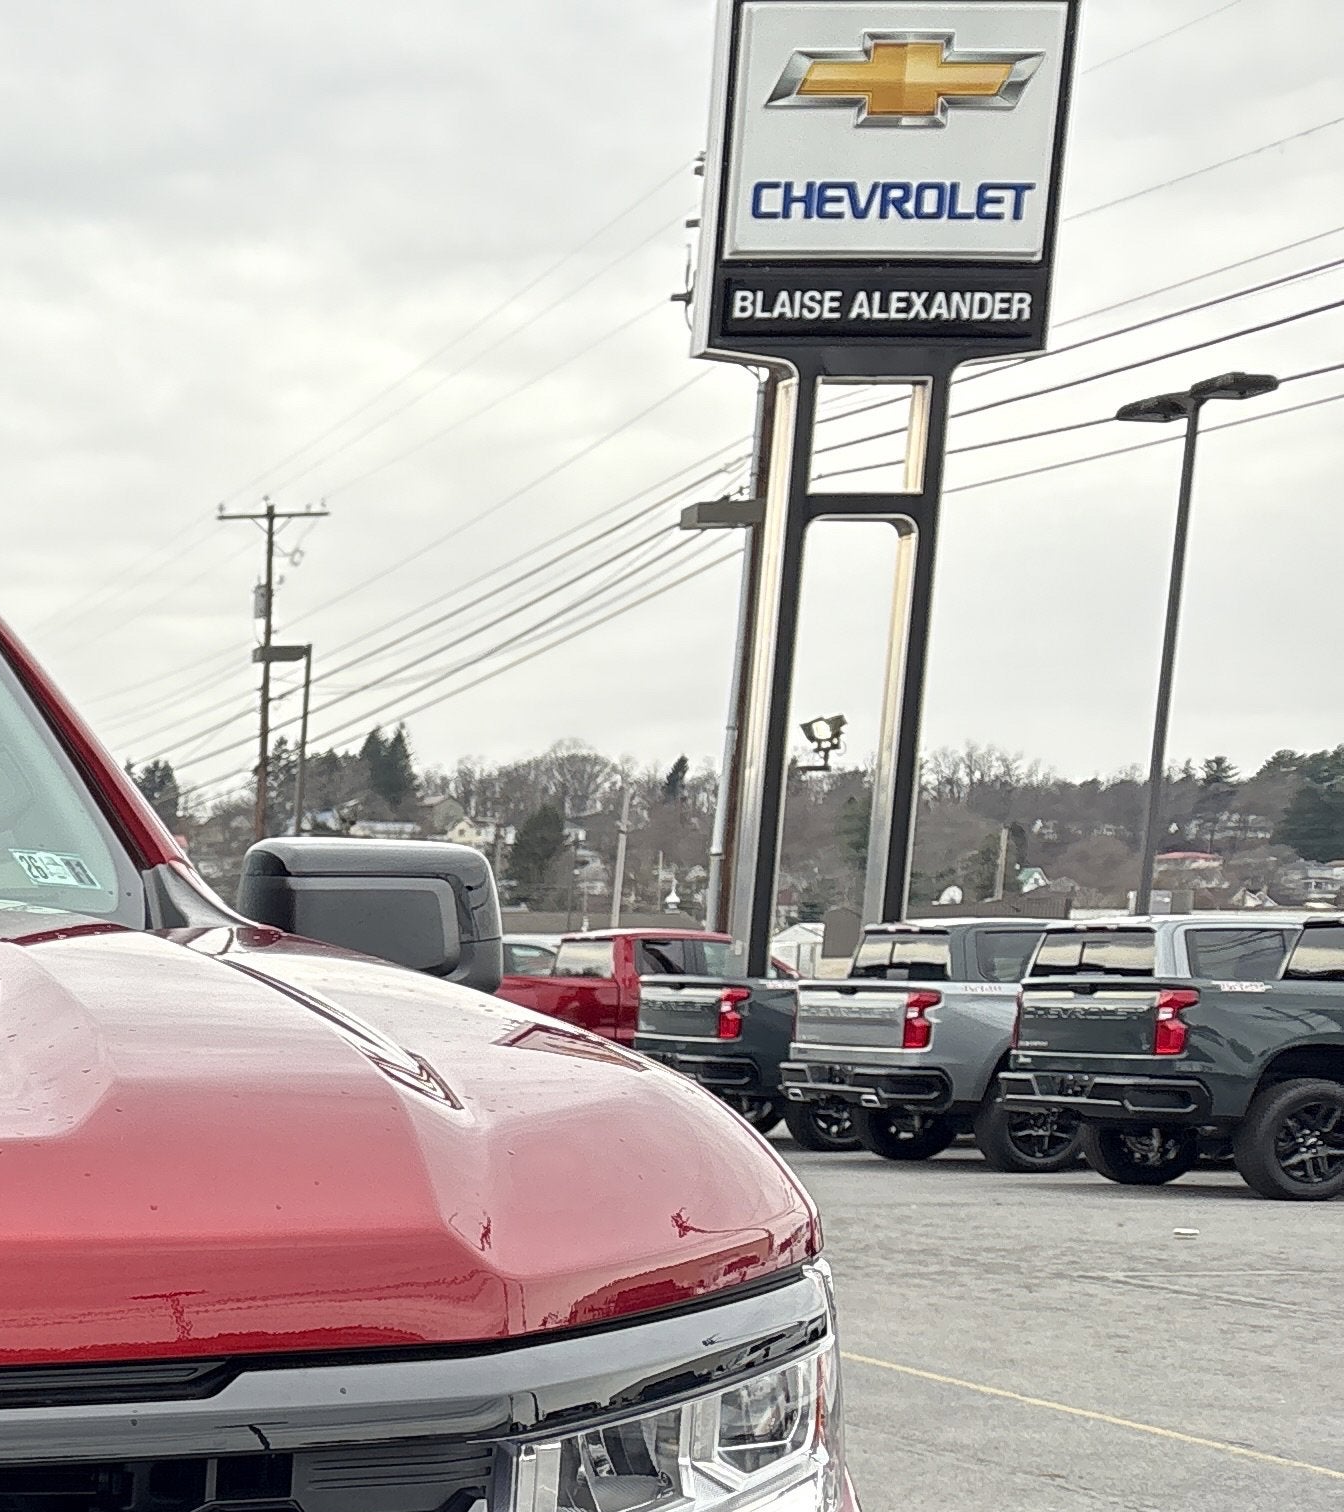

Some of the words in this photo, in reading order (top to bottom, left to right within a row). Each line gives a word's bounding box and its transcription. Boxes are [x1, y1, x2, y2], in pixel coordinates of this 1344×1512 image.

[751, 181, 1036, 221] CHEVROLET
[732, 290, 843, 321] BLAISE
[849, 291, 1032, 321] ALEXANDER
[799, 1005, 894, 1019] CHEVROLET
[1023, 1006, 1145, 1020] CHEVROLET
